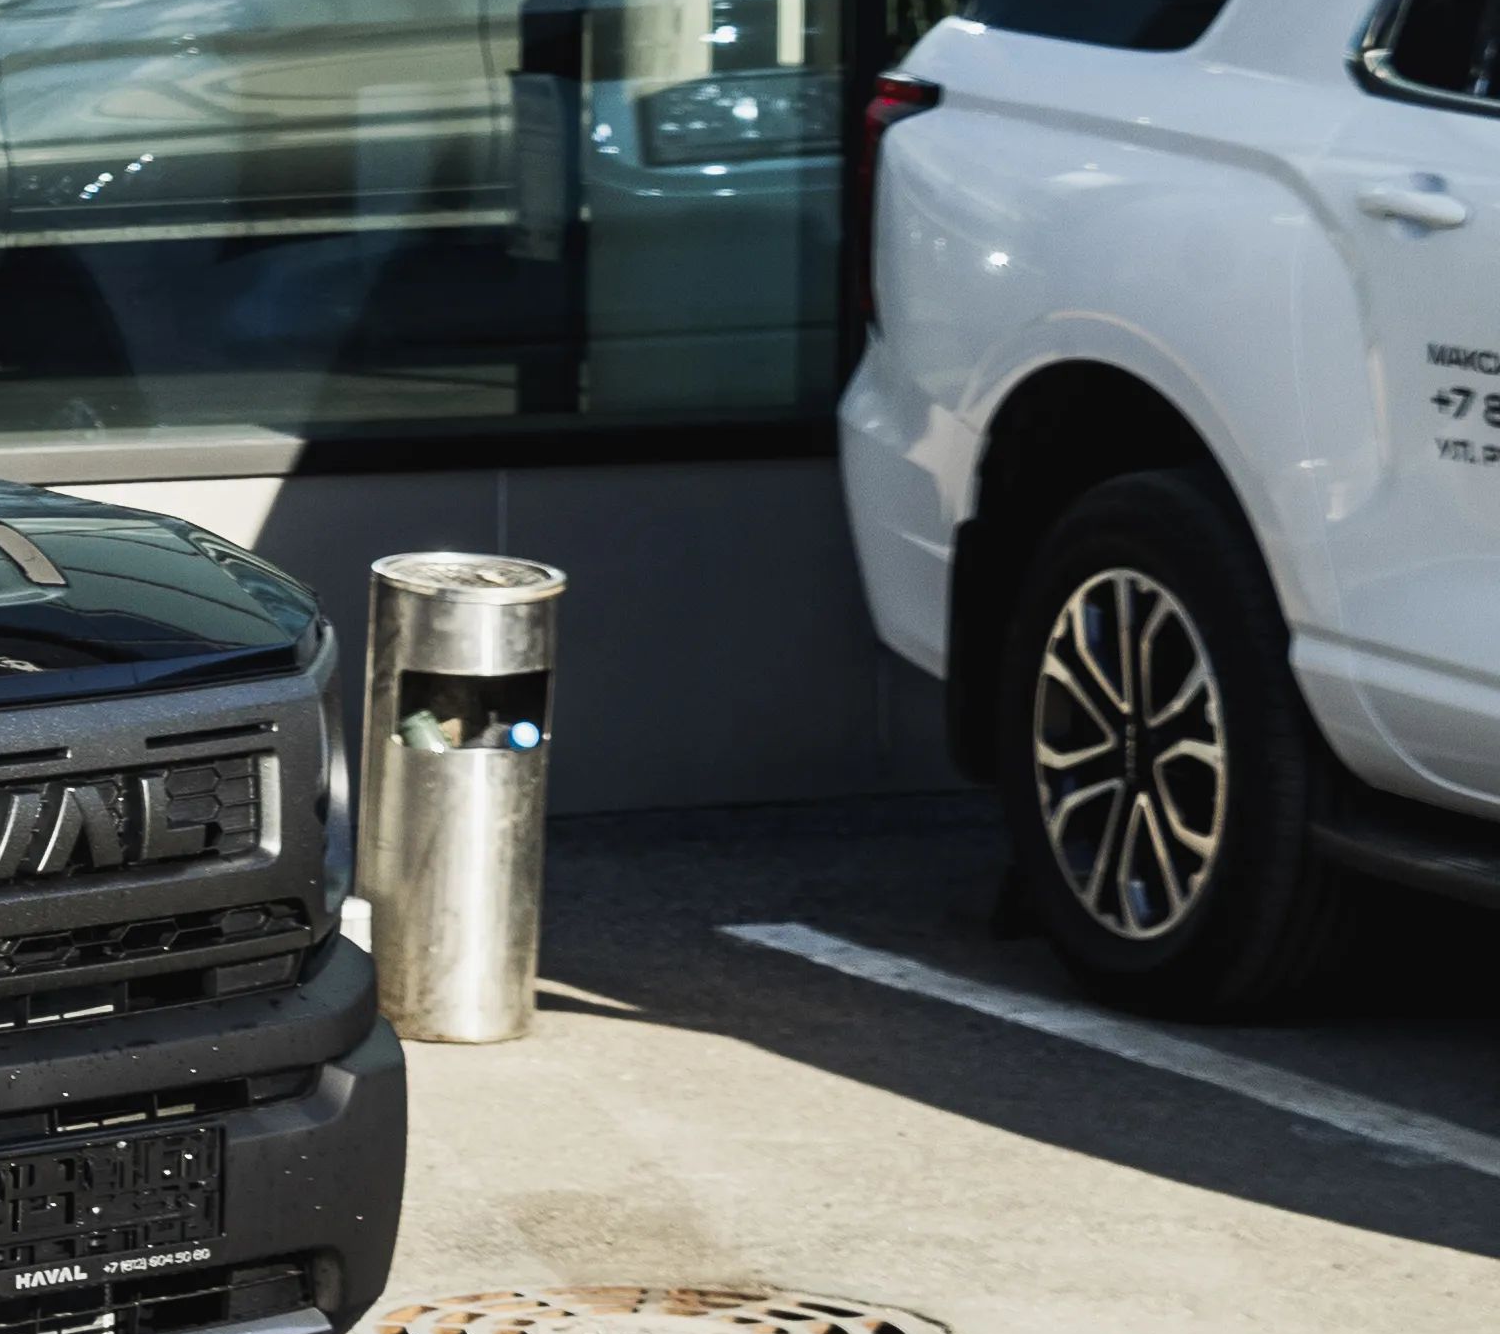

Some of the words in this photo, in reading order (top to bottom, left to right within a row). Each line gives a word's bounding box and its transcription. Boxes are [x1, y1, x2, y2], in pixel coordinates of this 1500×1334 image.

[1427, 342, 1500, 376] МАКС
[1430, 386, 1476, 420] +7
[15, 1265, 88, 1290] HAVAL
